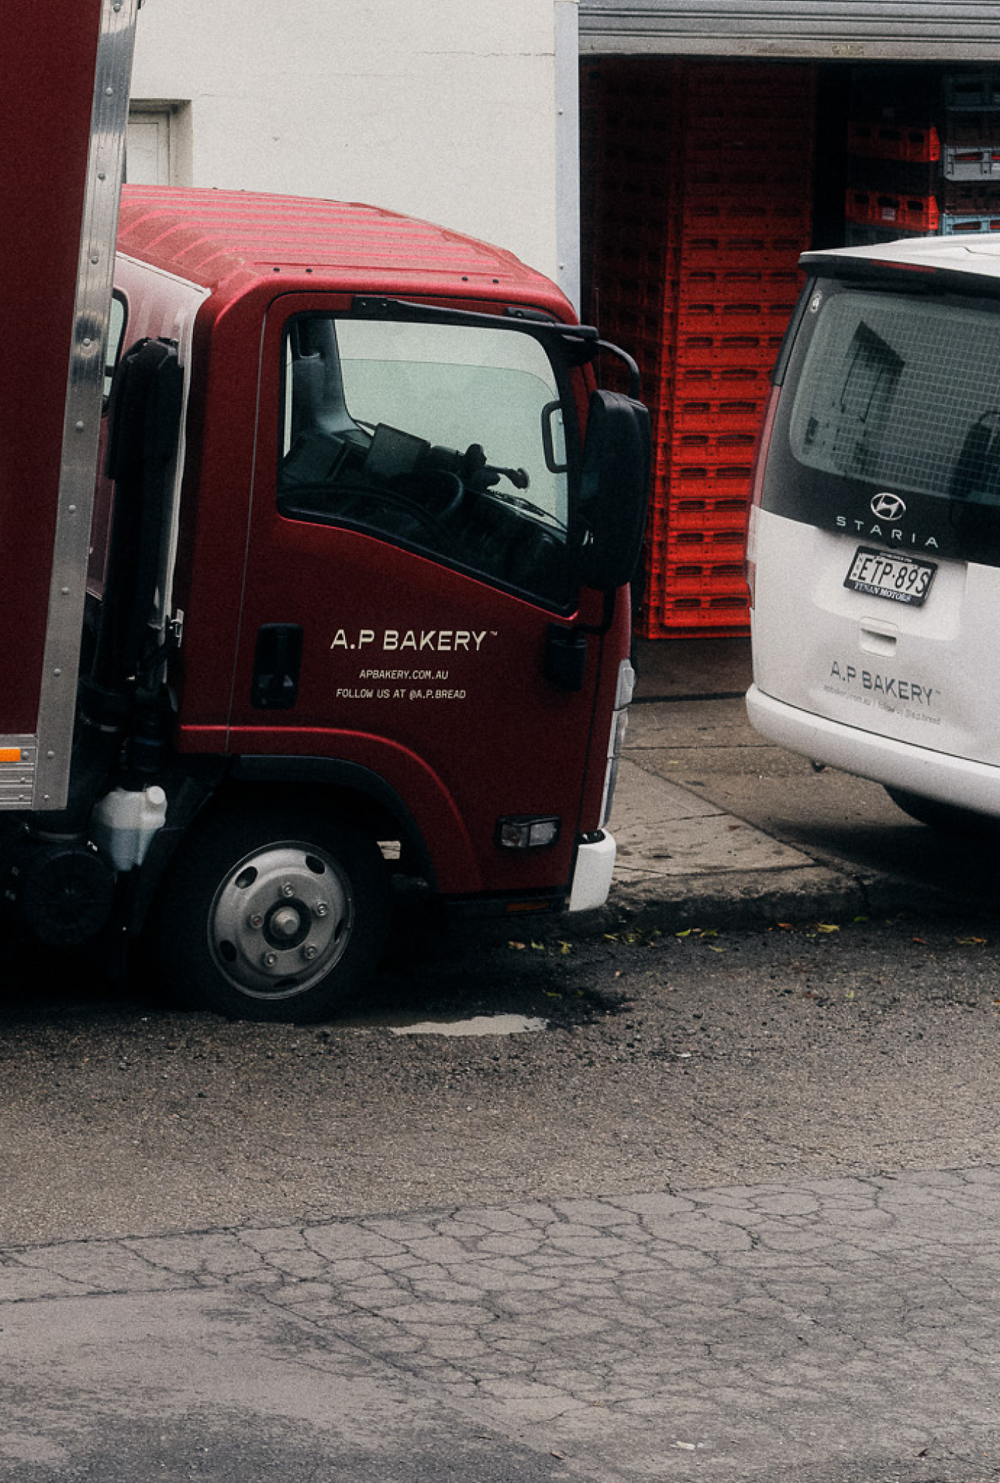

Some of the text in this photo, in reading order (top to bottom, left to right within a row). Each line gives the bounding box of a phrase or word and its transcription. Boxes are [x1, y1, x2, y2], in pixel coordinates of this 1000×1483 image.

[835, 515, 939, 548] STARIA
[329, 628, 375, 650] A.P
[382, 629, 488, 651] BAKERY
[358, 669, 449, 680] APBAKERY.COM.AU
[830, 660, 933, 706] A.P BAKERY
[335, 688, 466, 701] FOLLOW US AT @A.P.BREAD
